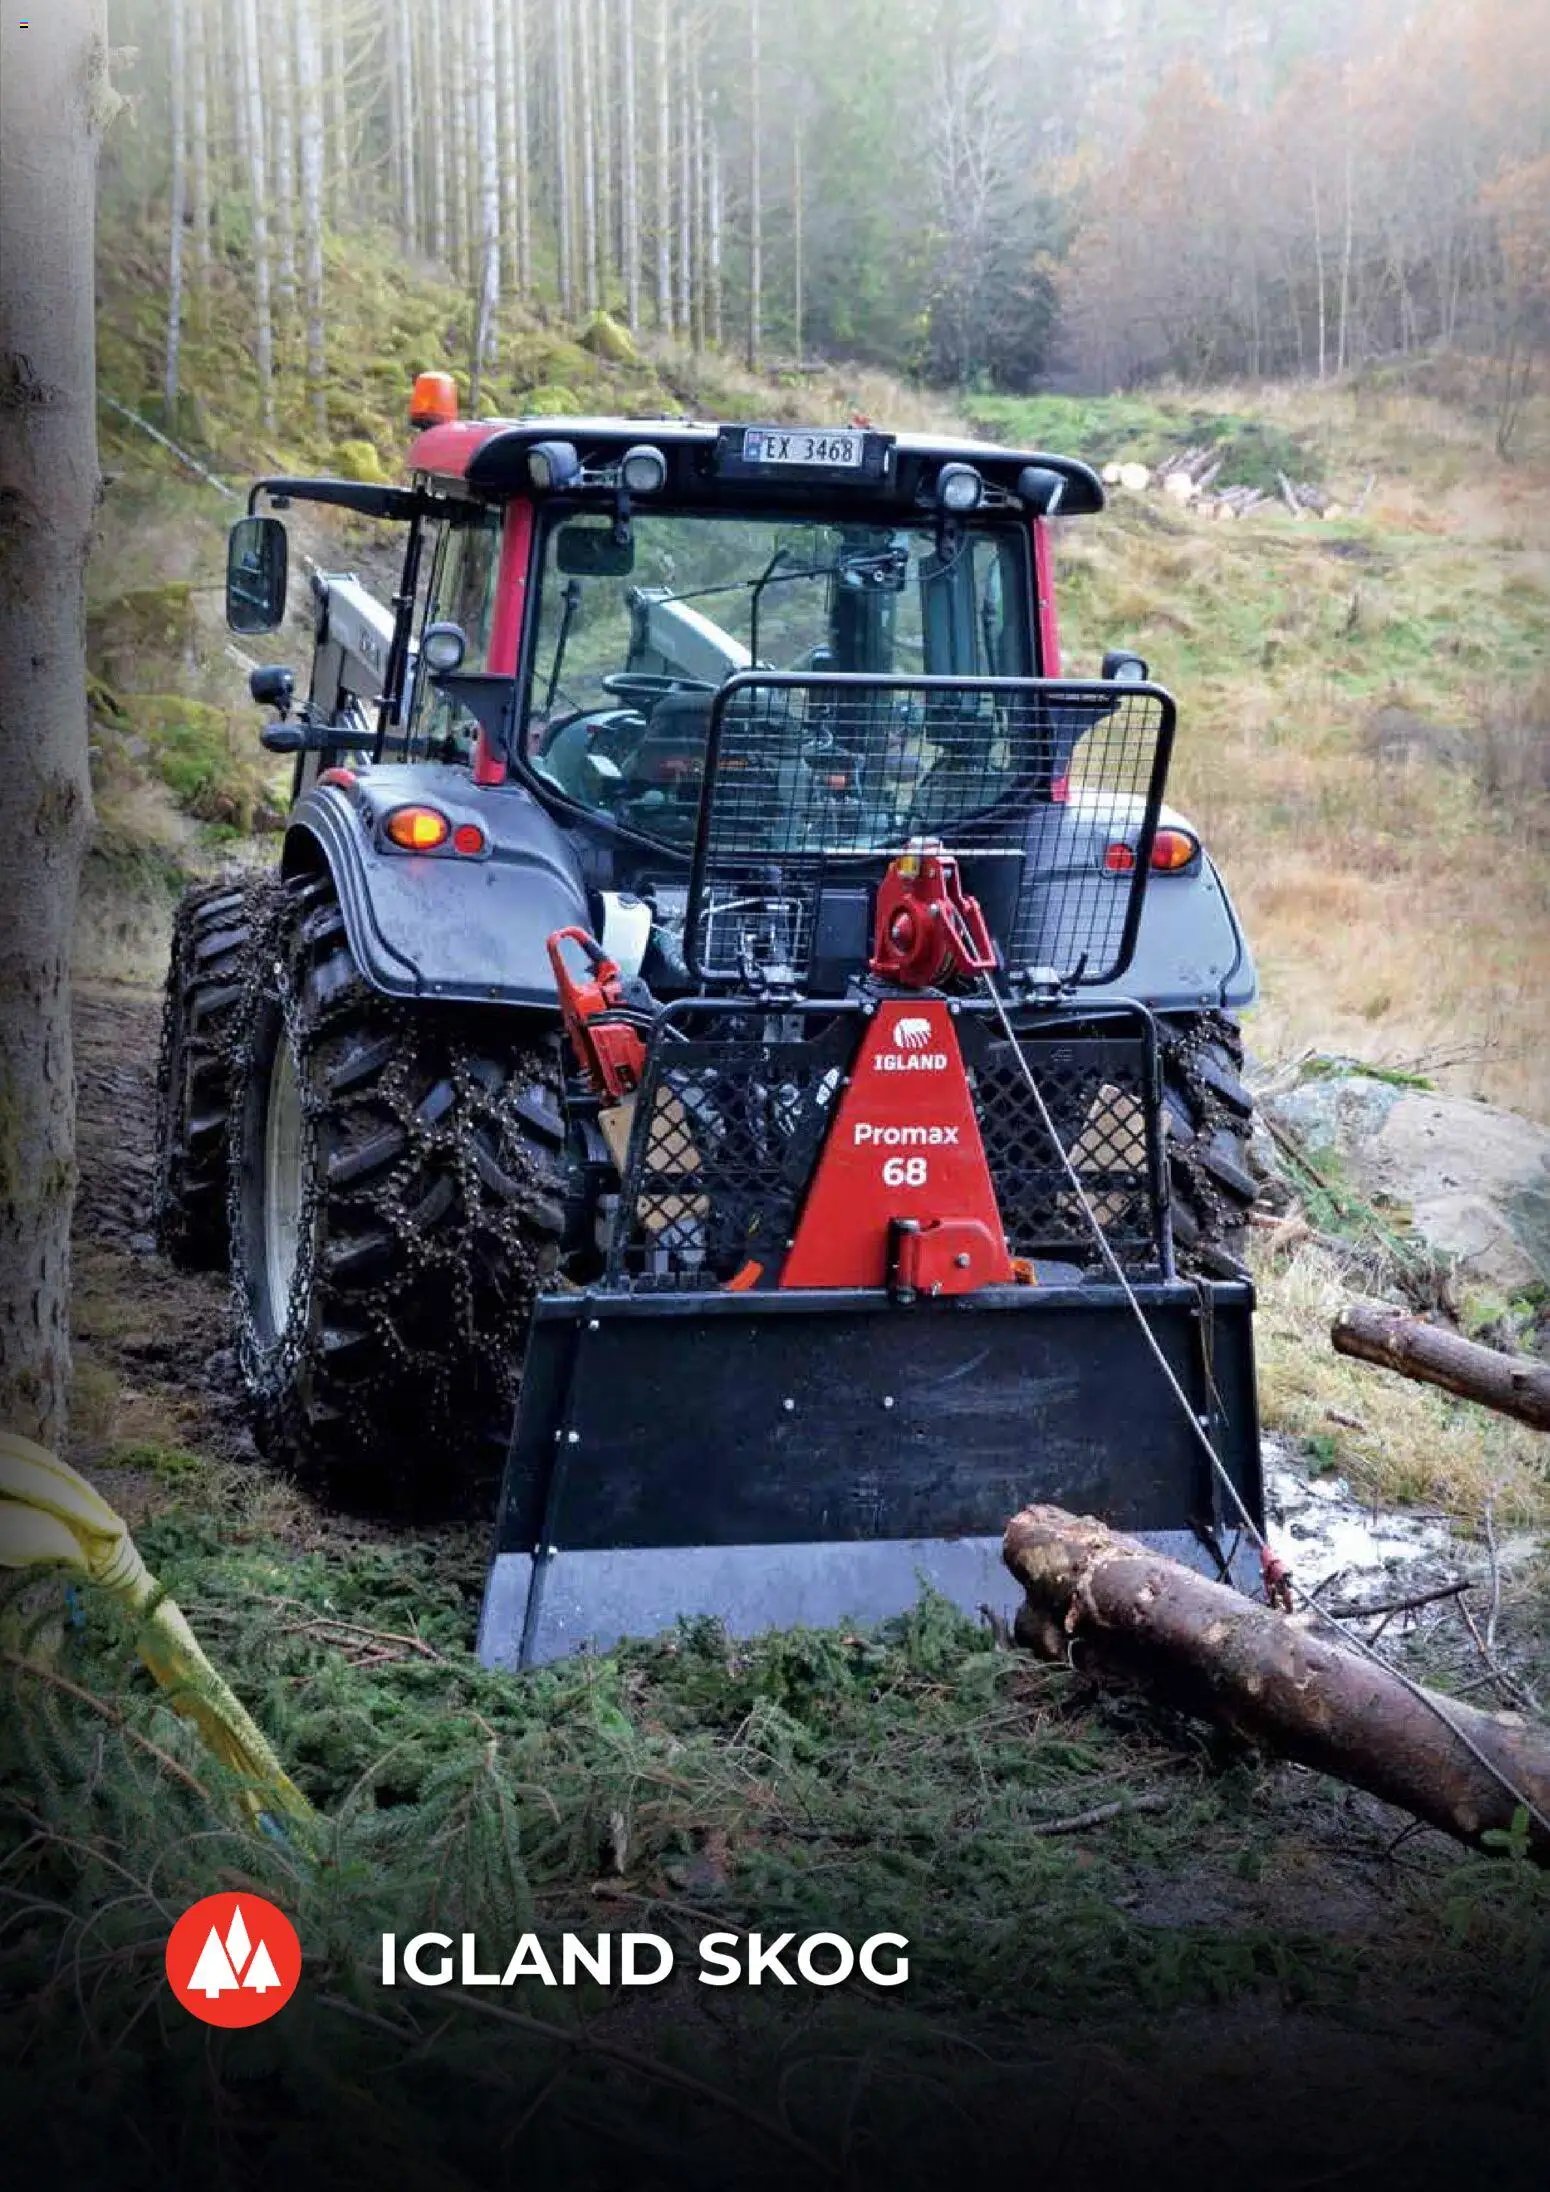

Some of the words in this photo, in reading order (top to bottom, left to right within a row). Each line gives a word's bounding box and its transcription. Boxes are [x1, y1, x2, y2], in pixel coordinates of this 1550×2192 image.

[766, 435, 790, 459] EX
[804, 438, 853, 462] 3468
[874, 1054, 948, 1071] IGLAND
[854, 1122, 959, 1145] Promax
[882, 1157, 927, 1187] 68
